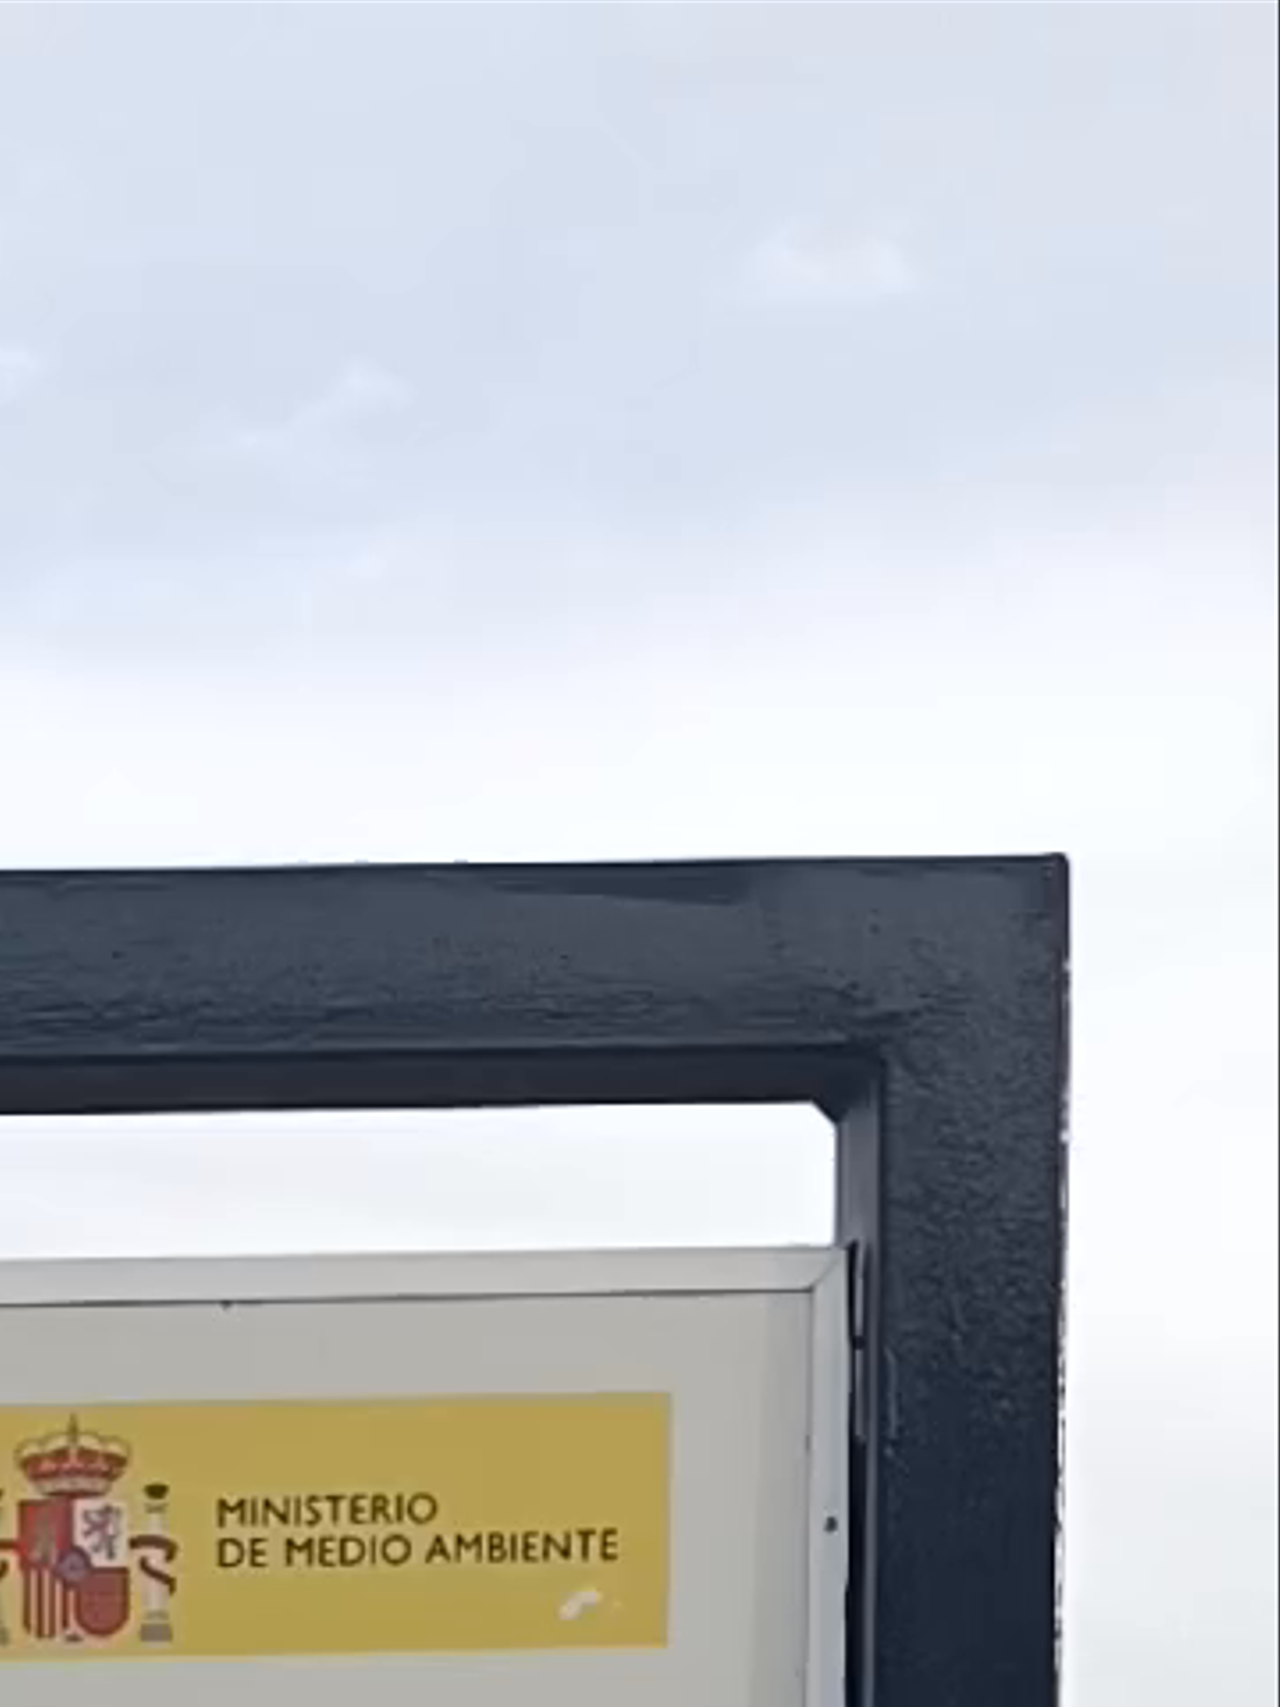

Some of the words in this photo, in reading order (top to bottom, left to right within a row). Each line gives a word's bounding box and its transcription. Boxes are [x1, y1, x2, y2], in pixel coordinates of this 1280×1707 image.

[215, 1492, 438, 1527] MINISTERIO
[216, 1536, 268, 1569] DE
[284, 1534, 412, 1568] MEDIO
[426, 1527, 620, 1565] AMBIENTE
